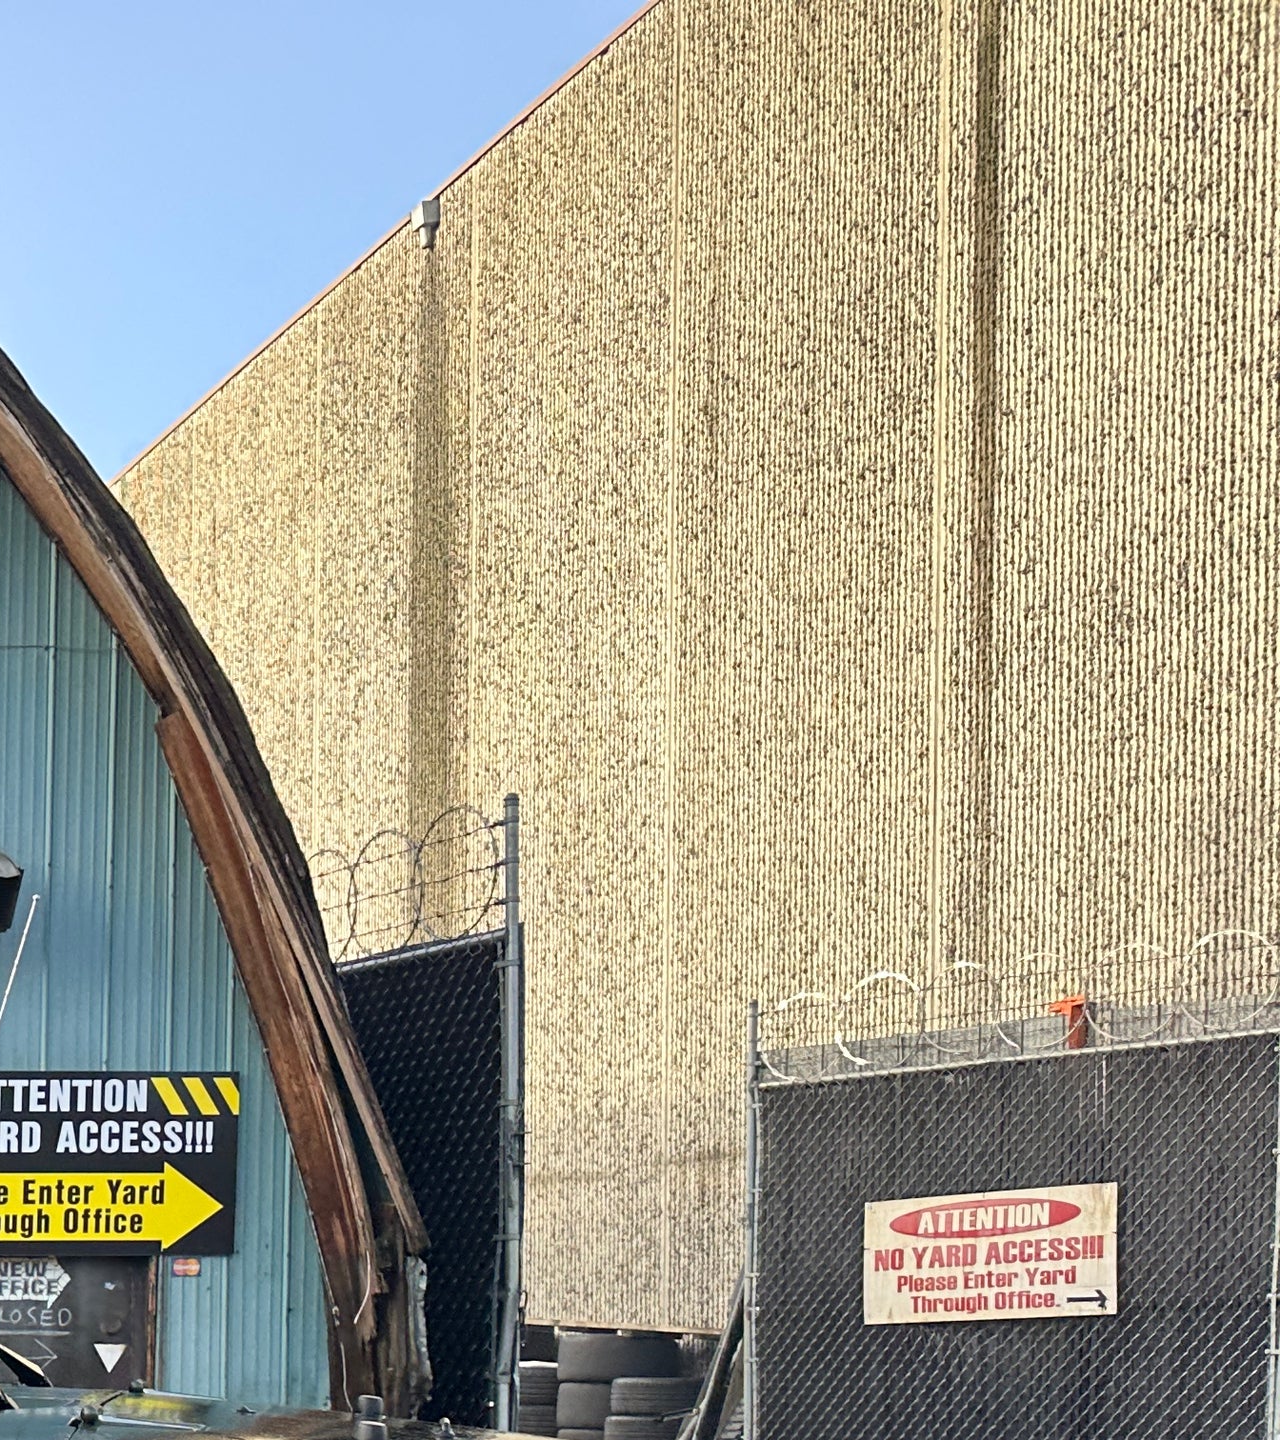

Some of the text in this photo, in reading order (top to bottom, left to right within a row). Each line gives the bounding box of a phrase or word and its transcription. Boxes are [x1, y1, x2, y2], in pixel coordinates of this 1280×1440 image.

[56, 1121, 215, 1153] ACCESS!!!
[23, 1180, 95, 1205] Enter
[107, 1180, 166, 1205] Yard
[63, 1210, 144, 1234] Office
[917, 1202, 1050, 1234] ATTENTION
[874, 1235, 1104, 1272] NO YARD ACCESS!!!
[896, 1266, 1077, 1293] Please Enter Yard
[910, 1292, 1060, 1314] Through Office.
